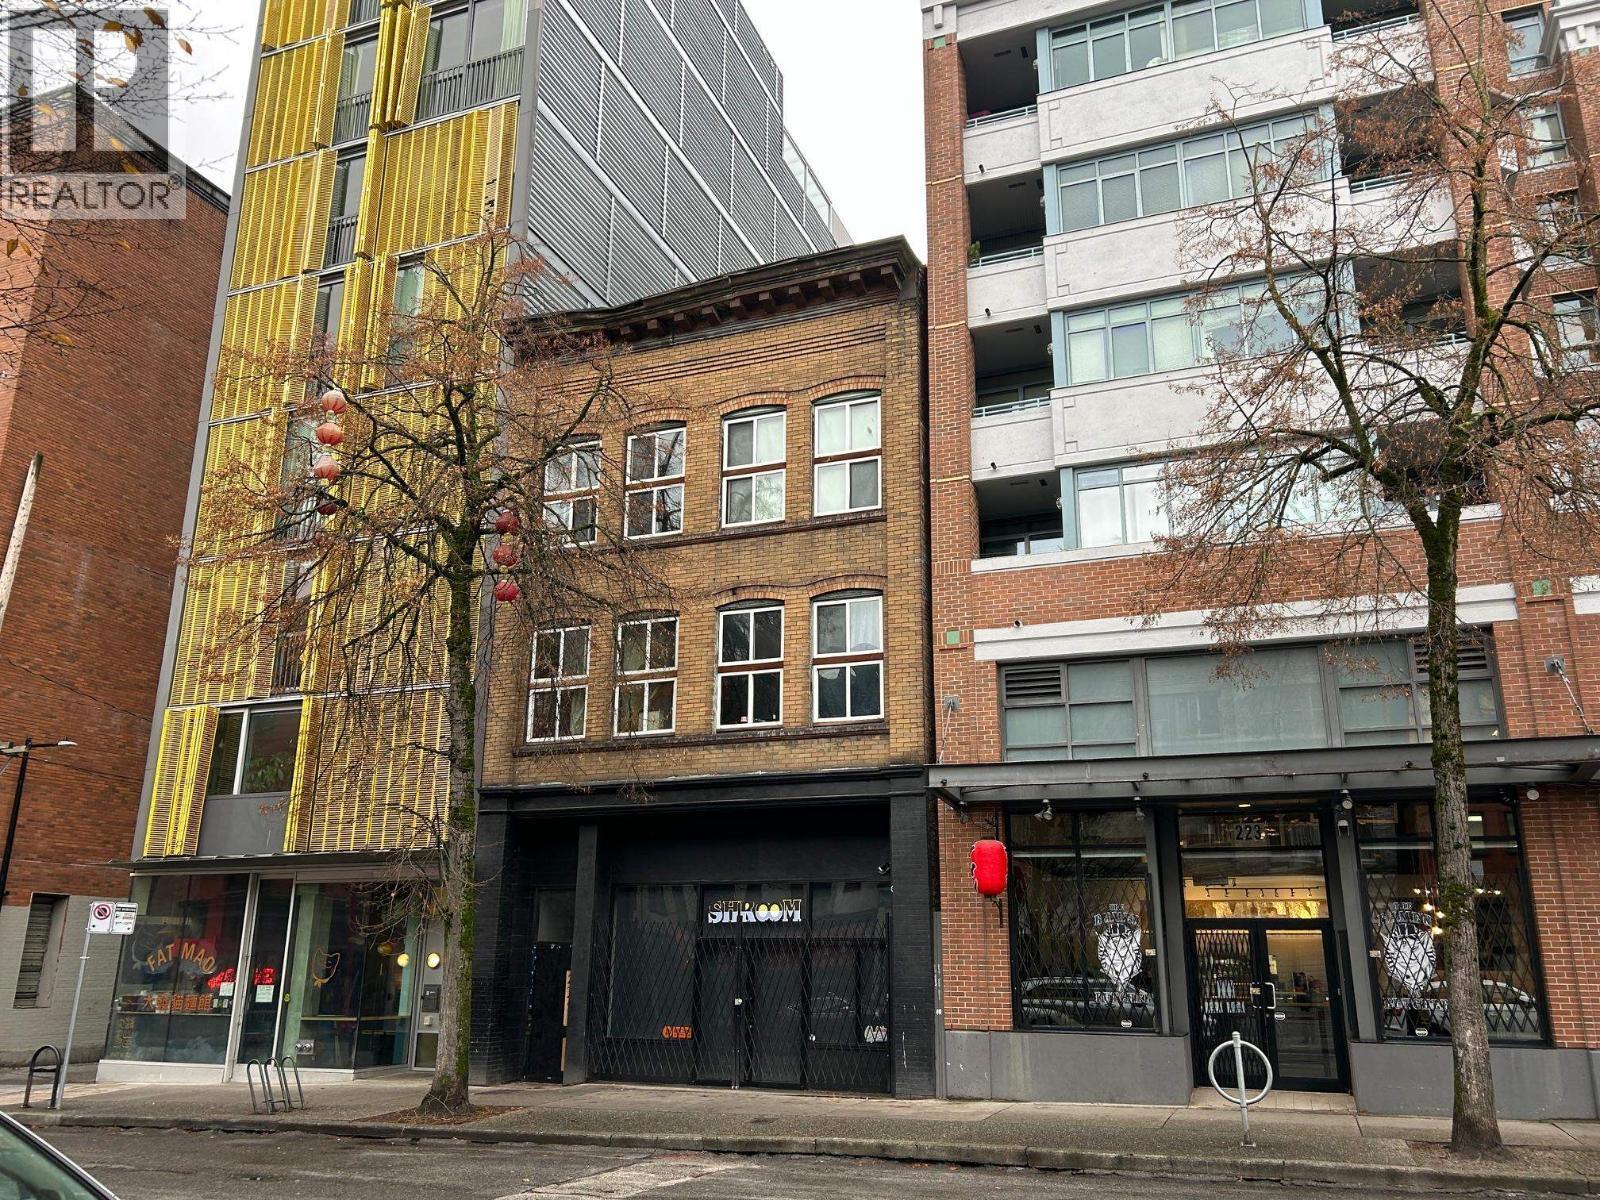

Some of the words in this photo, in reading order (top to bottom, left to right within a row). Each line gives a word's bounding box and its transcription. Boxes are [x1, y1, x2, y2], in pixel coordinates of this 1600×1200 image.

[1236, 825, 1261, 840] 223
[708, 899, 802, 924] SHROOM
[147, 943, 174, 972] FAT
[181, 942, 215, 973] MAO
